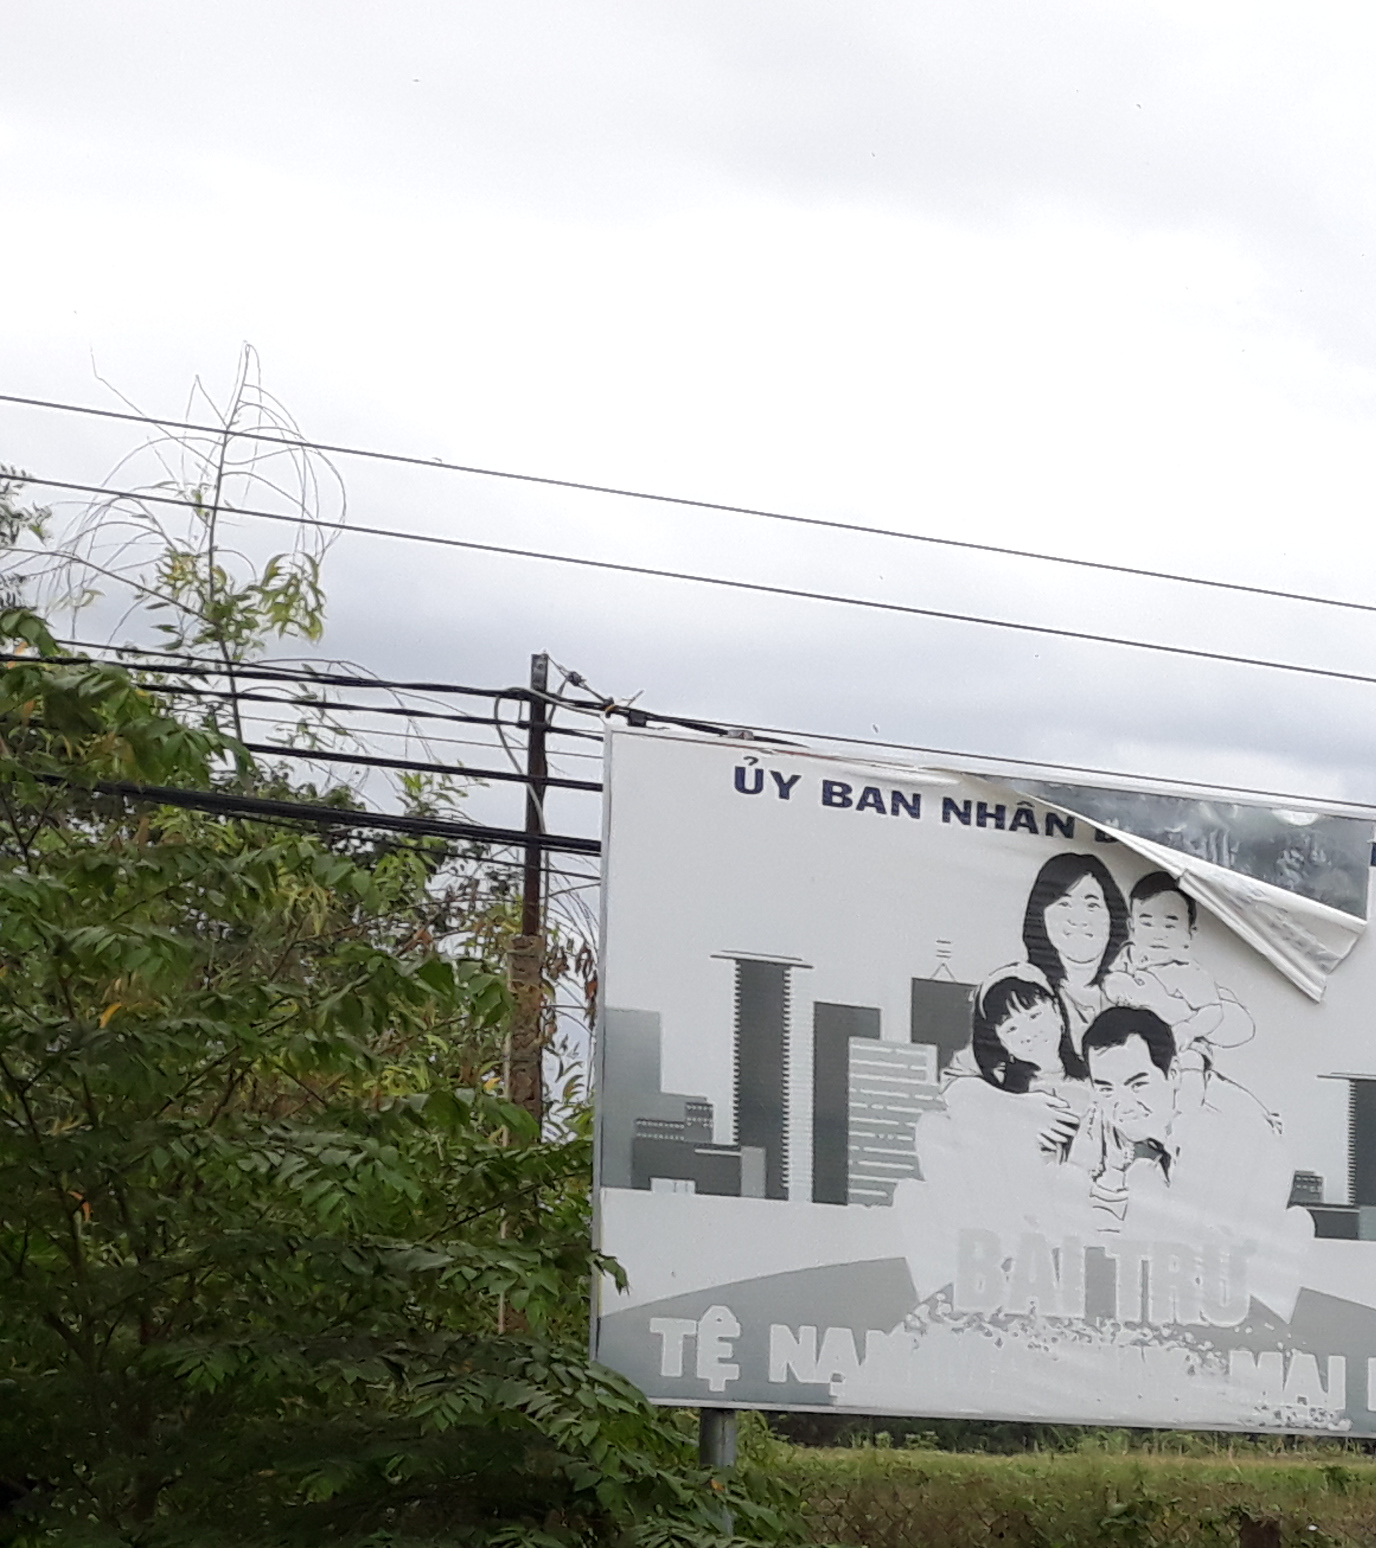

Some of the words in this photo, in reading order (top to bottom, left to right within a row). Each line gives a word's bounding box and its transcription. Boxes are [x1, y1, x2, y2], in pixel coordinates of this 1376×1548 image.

[733, 756, 801, 800] ỦY
[821, 779, 921, 819] BAN
[942, 799, 1076, 839] NHÂN
[649, 1305, 742, 1393] TỆ
